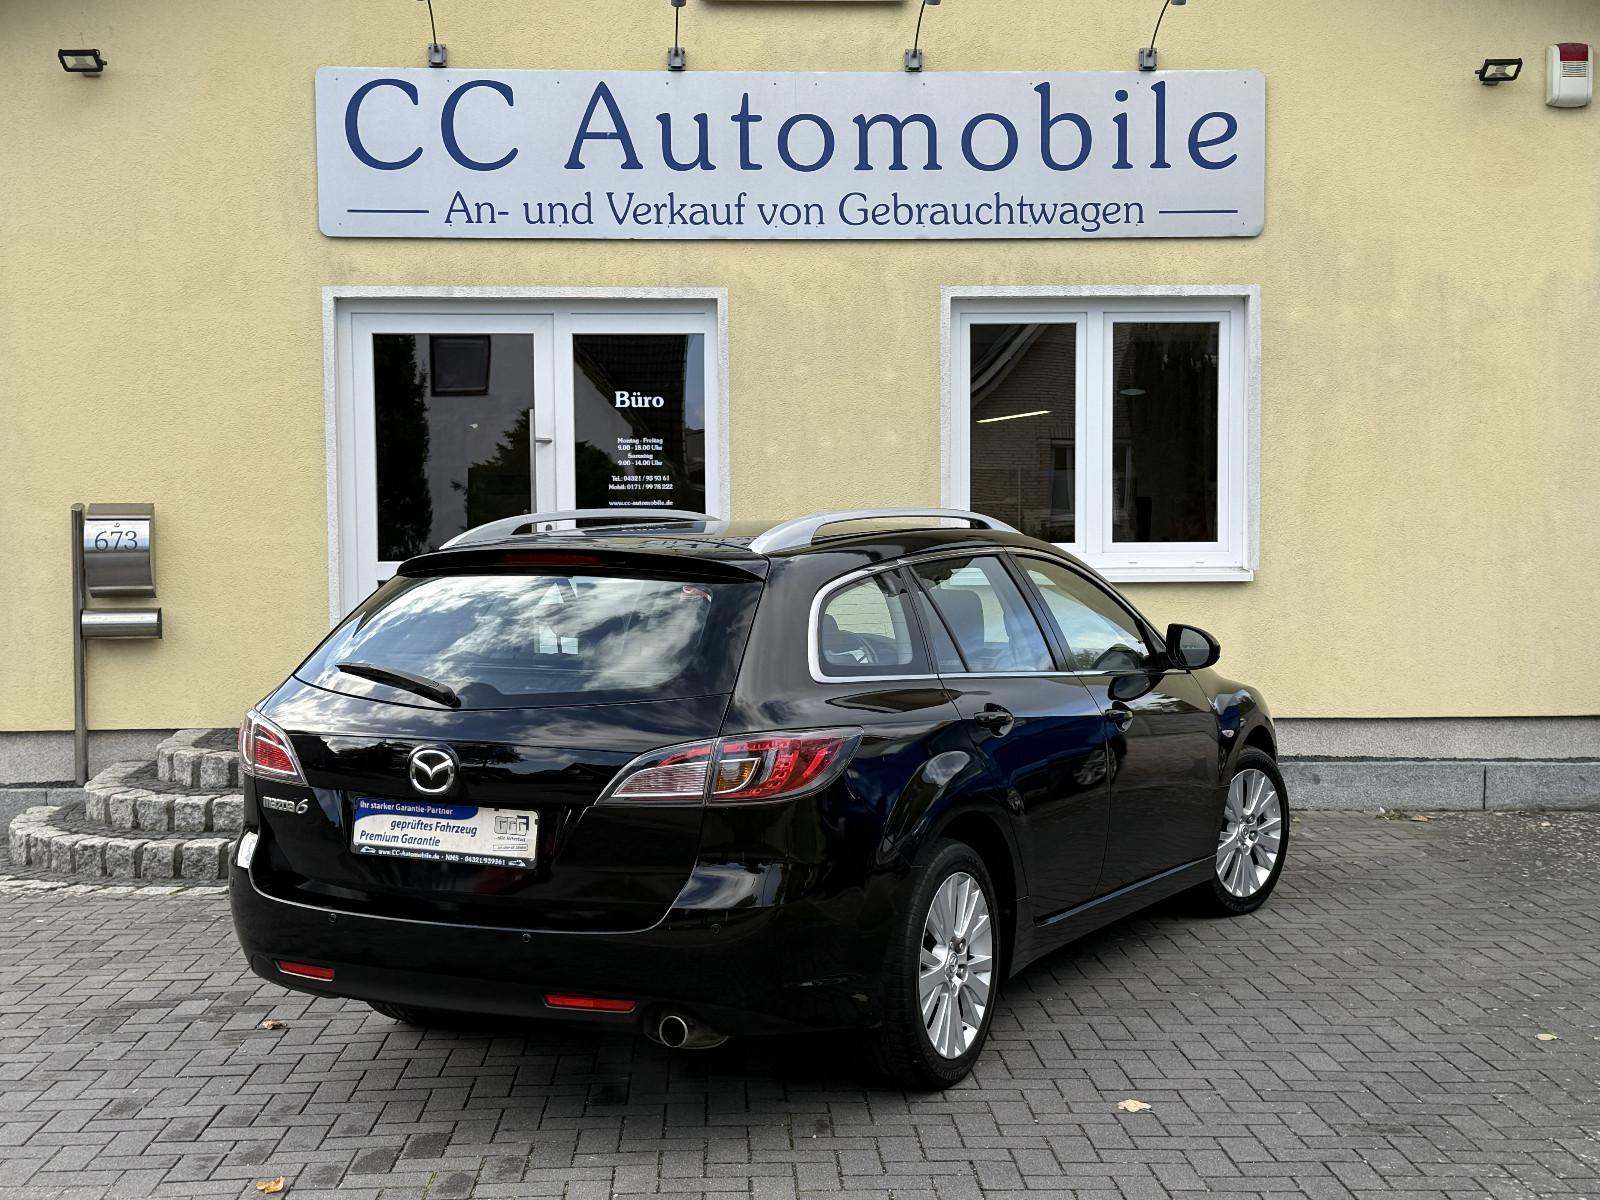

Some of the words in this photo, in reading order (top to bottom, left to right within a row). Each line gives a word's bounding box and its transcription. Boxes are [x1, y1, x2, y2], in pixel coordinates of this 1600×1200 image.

[345, 79, 518, 172] CC
[565, 81, 1238, 173] Automobile
[444, 191, 509, 224] An-
[522, 191, 594, 225] und
[606, 192, 747, 226] Verkauf
[757, 202, 825, 226] von
[838, 192, 1144, 233] Gebrauchtwagen
[614, 390, 665, 408] Büro
[627, 452, 654, 460] Samstag
[94, 530, 138, 551] 673
[360, 800, 370, 809] Ihr
[370, 802, 394, 811] starker
[395, 803, 454, 816] Garantie-Partner
[390, 819, 433, 832] geprüftes
[434, 821, 478, 838] Fahrzeug
[360, 829, 400, 843] Premium
[400, 833, 441, 847] Garantie
